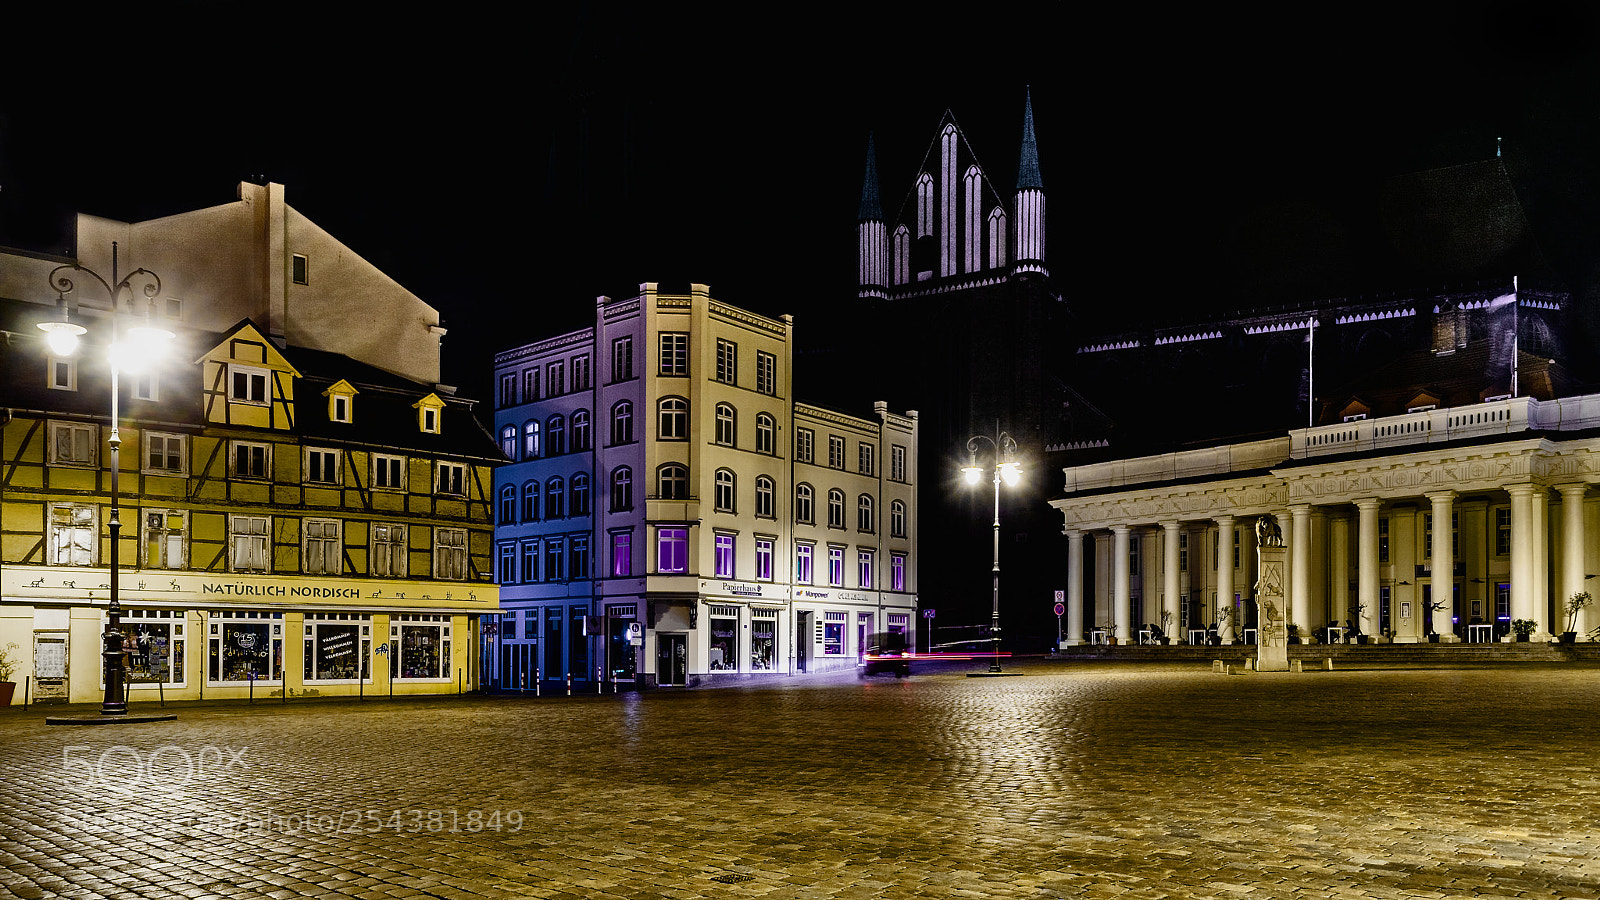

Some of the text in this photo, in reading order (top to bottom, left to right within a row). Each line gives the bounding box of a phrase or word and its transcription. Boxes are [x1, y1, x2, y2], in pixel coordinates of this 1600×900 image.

[202, 581, 360, 599] NATÜRLICH NORDISCH
[722, 582, 757, 594] Papierhaus
